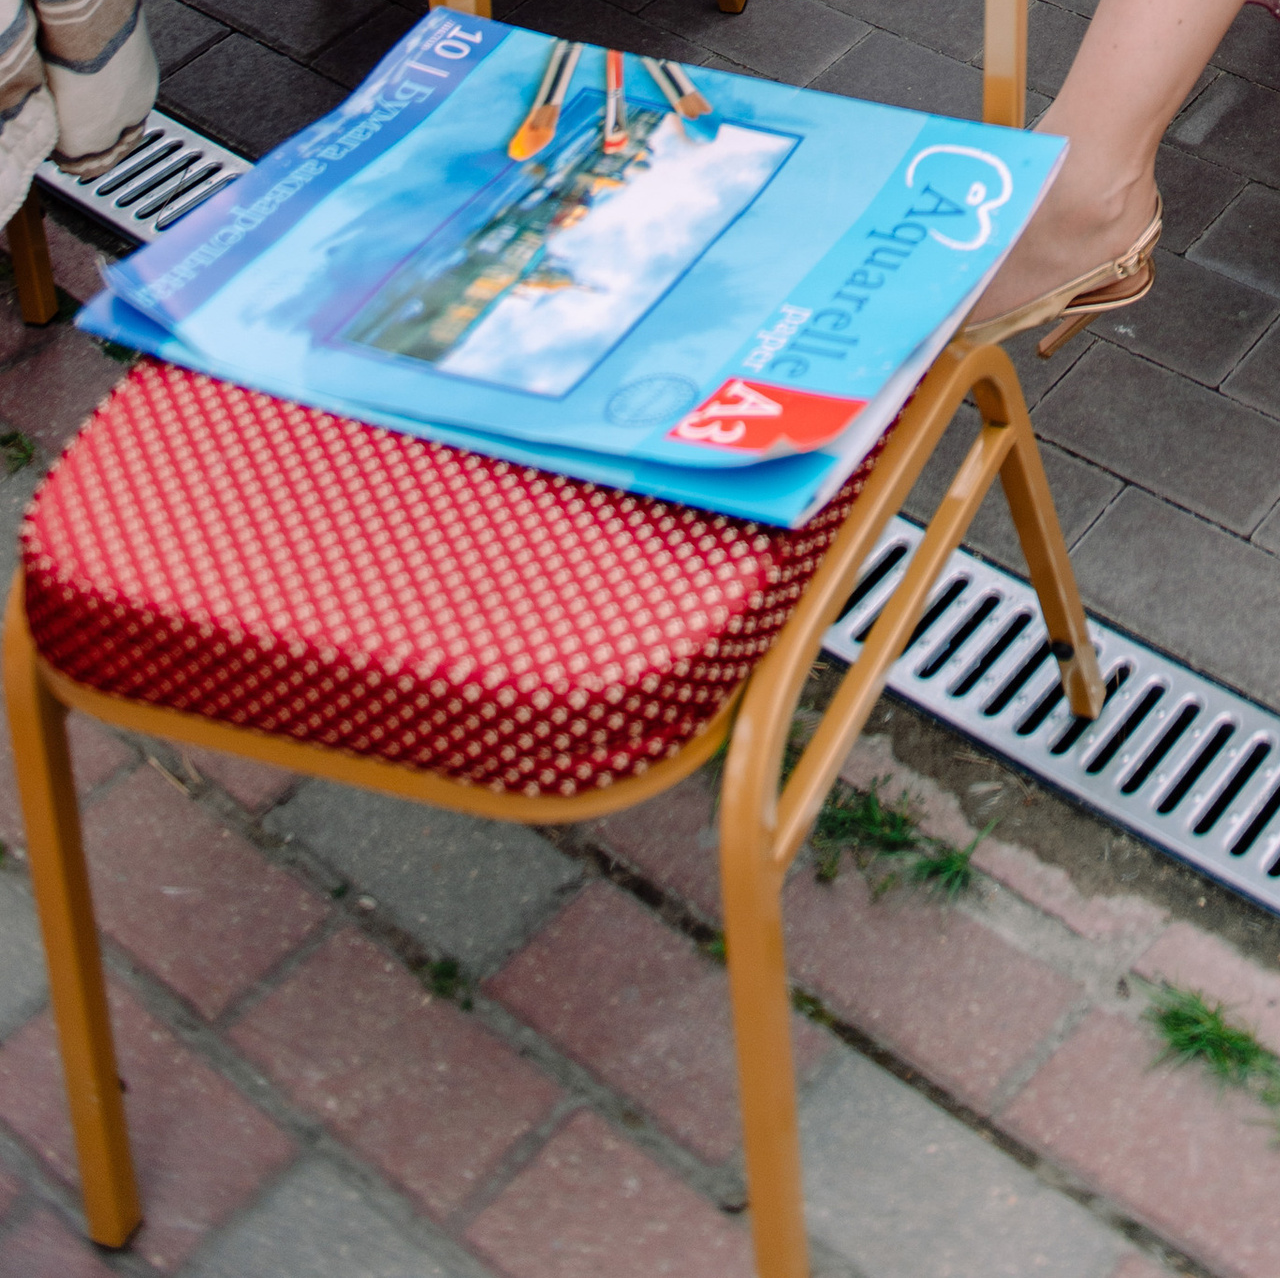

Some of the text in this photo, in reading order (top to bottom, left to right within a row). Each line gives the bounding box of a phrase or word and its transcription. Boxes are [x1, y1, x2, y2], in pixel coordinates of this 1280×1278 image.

[433, 25, 483, 60] 10
[318, 78, 437, 162] Бумага
[768, 184, 966, 378] Aquarelle
[742, 303, 812, 372] paper
[677, 380, 783, 444] A3
